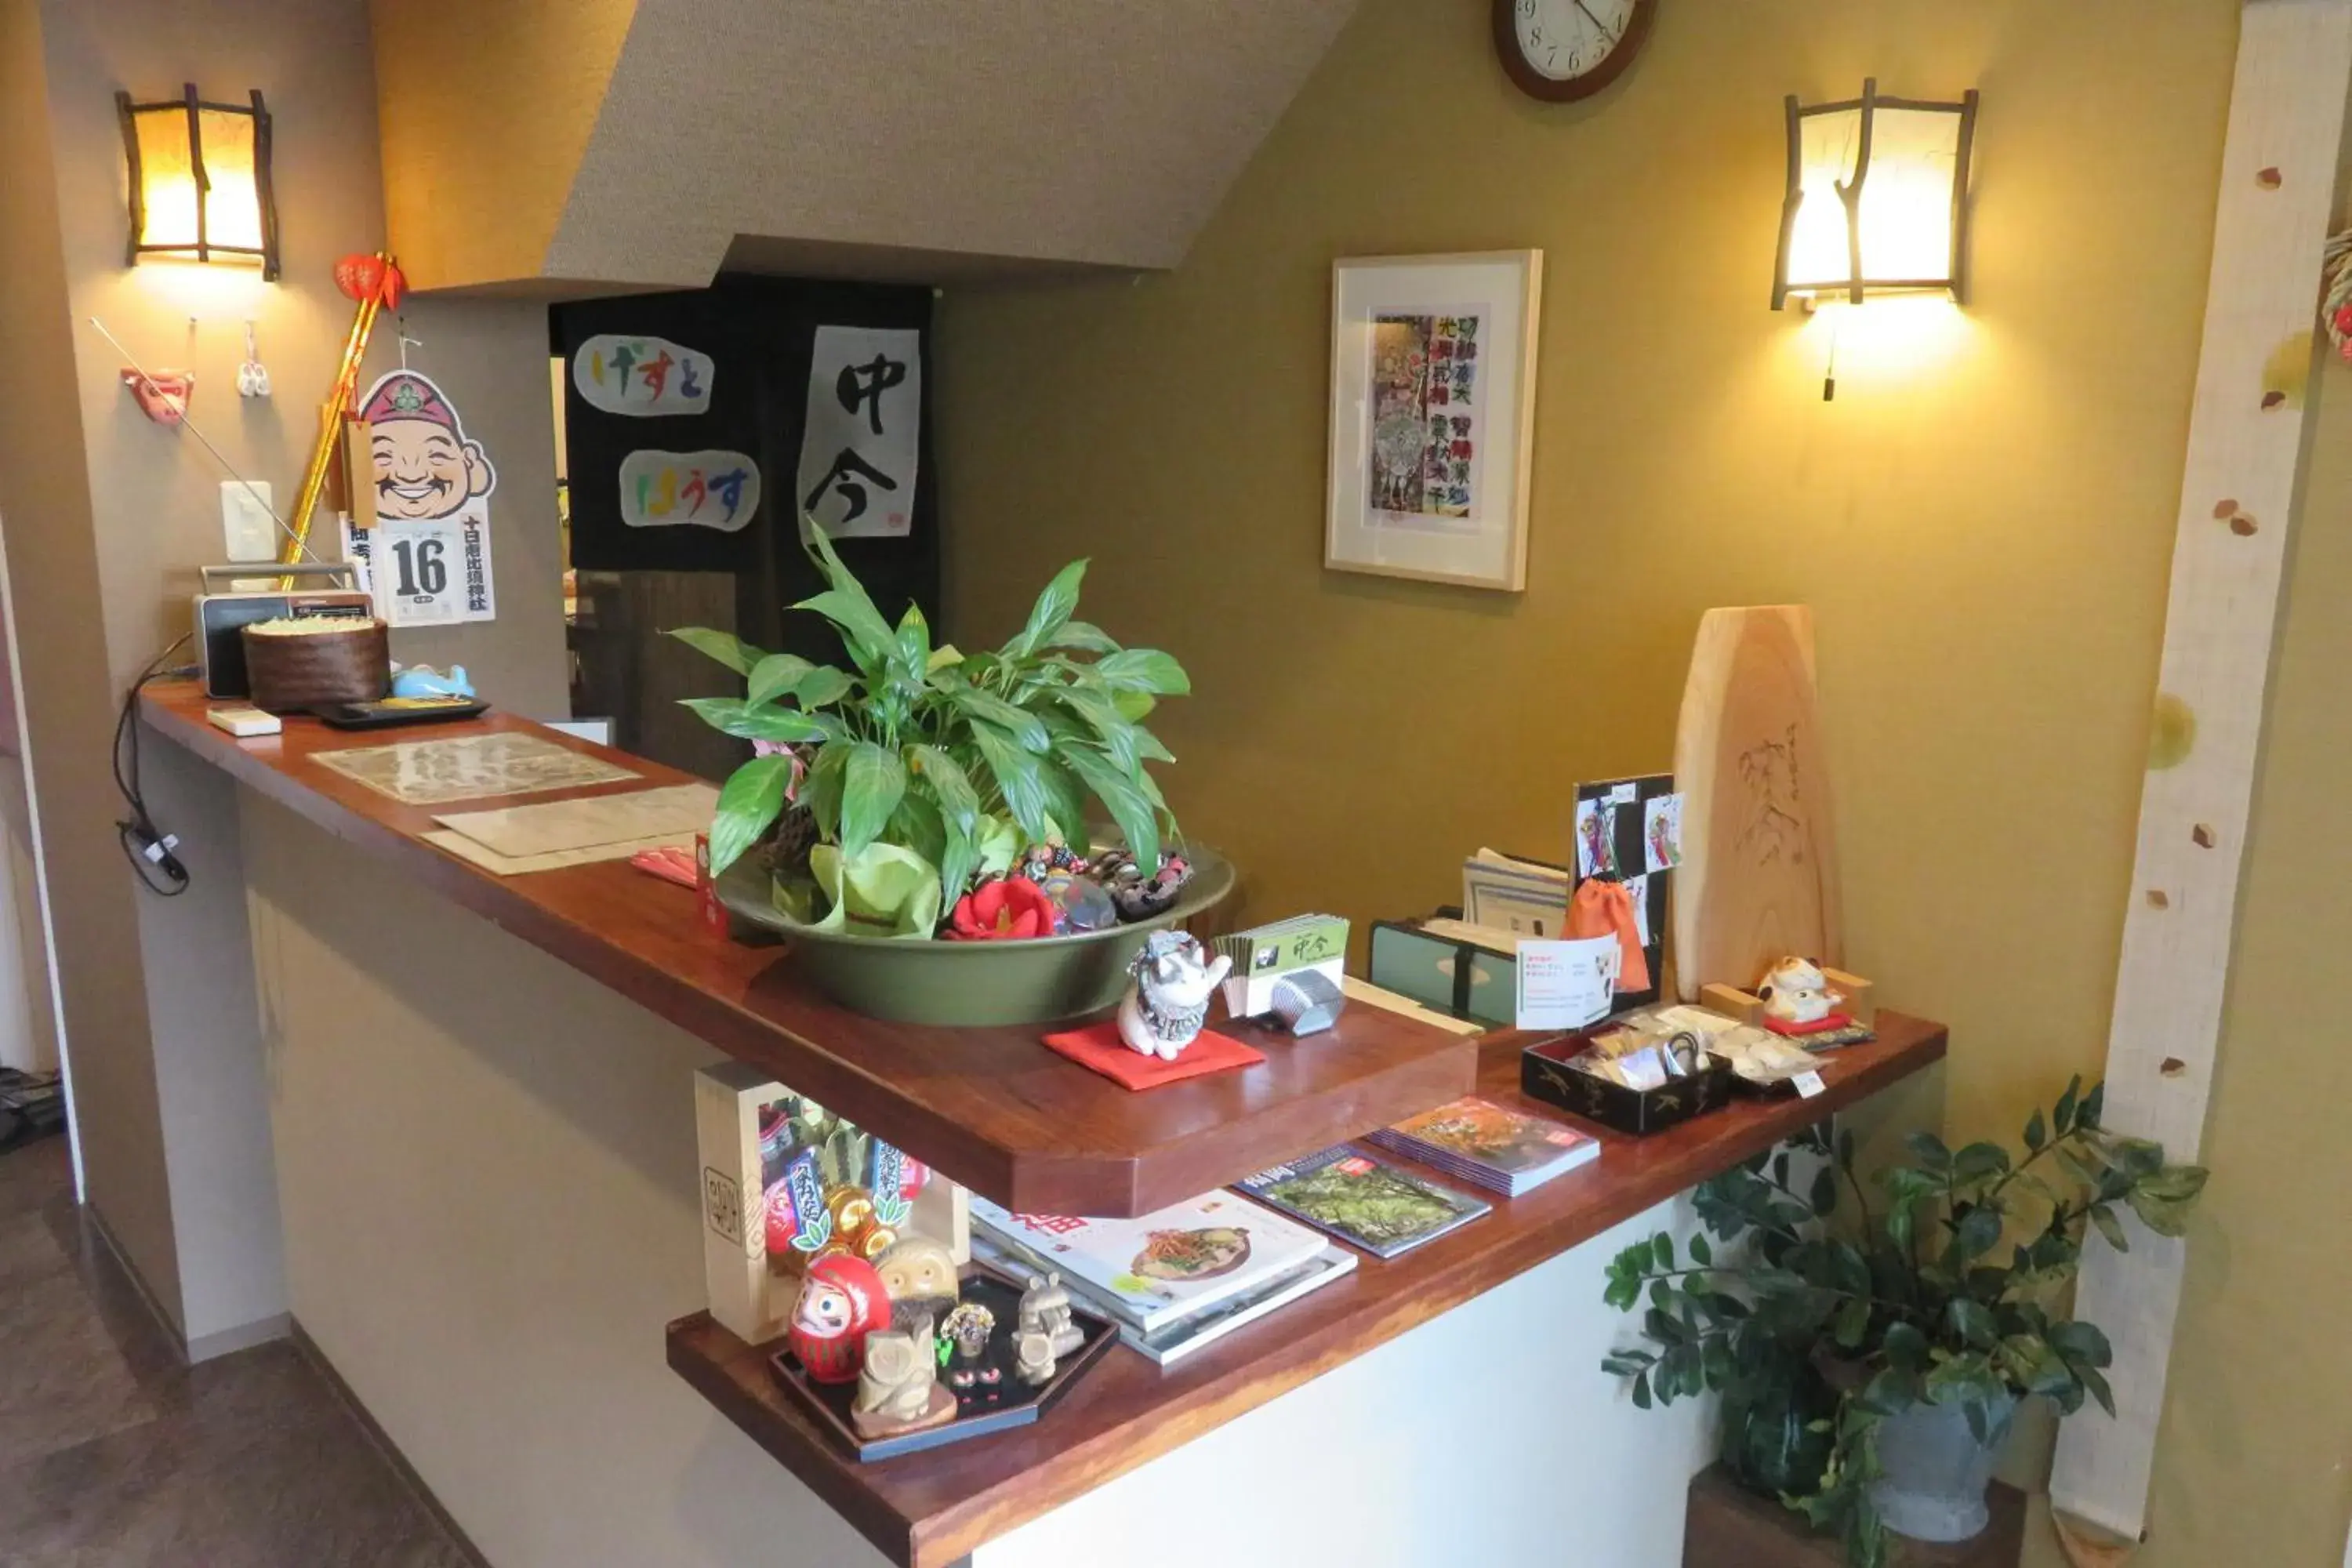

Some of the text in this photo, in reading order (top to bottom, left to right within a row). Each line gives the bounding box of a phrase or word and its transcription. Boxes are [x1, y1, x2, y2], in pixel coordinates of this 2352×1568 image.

[1548, 45, 1558, 67] 7
[1568, 50, 1580, 71] 6
[391, 539, 447, 596] 16
